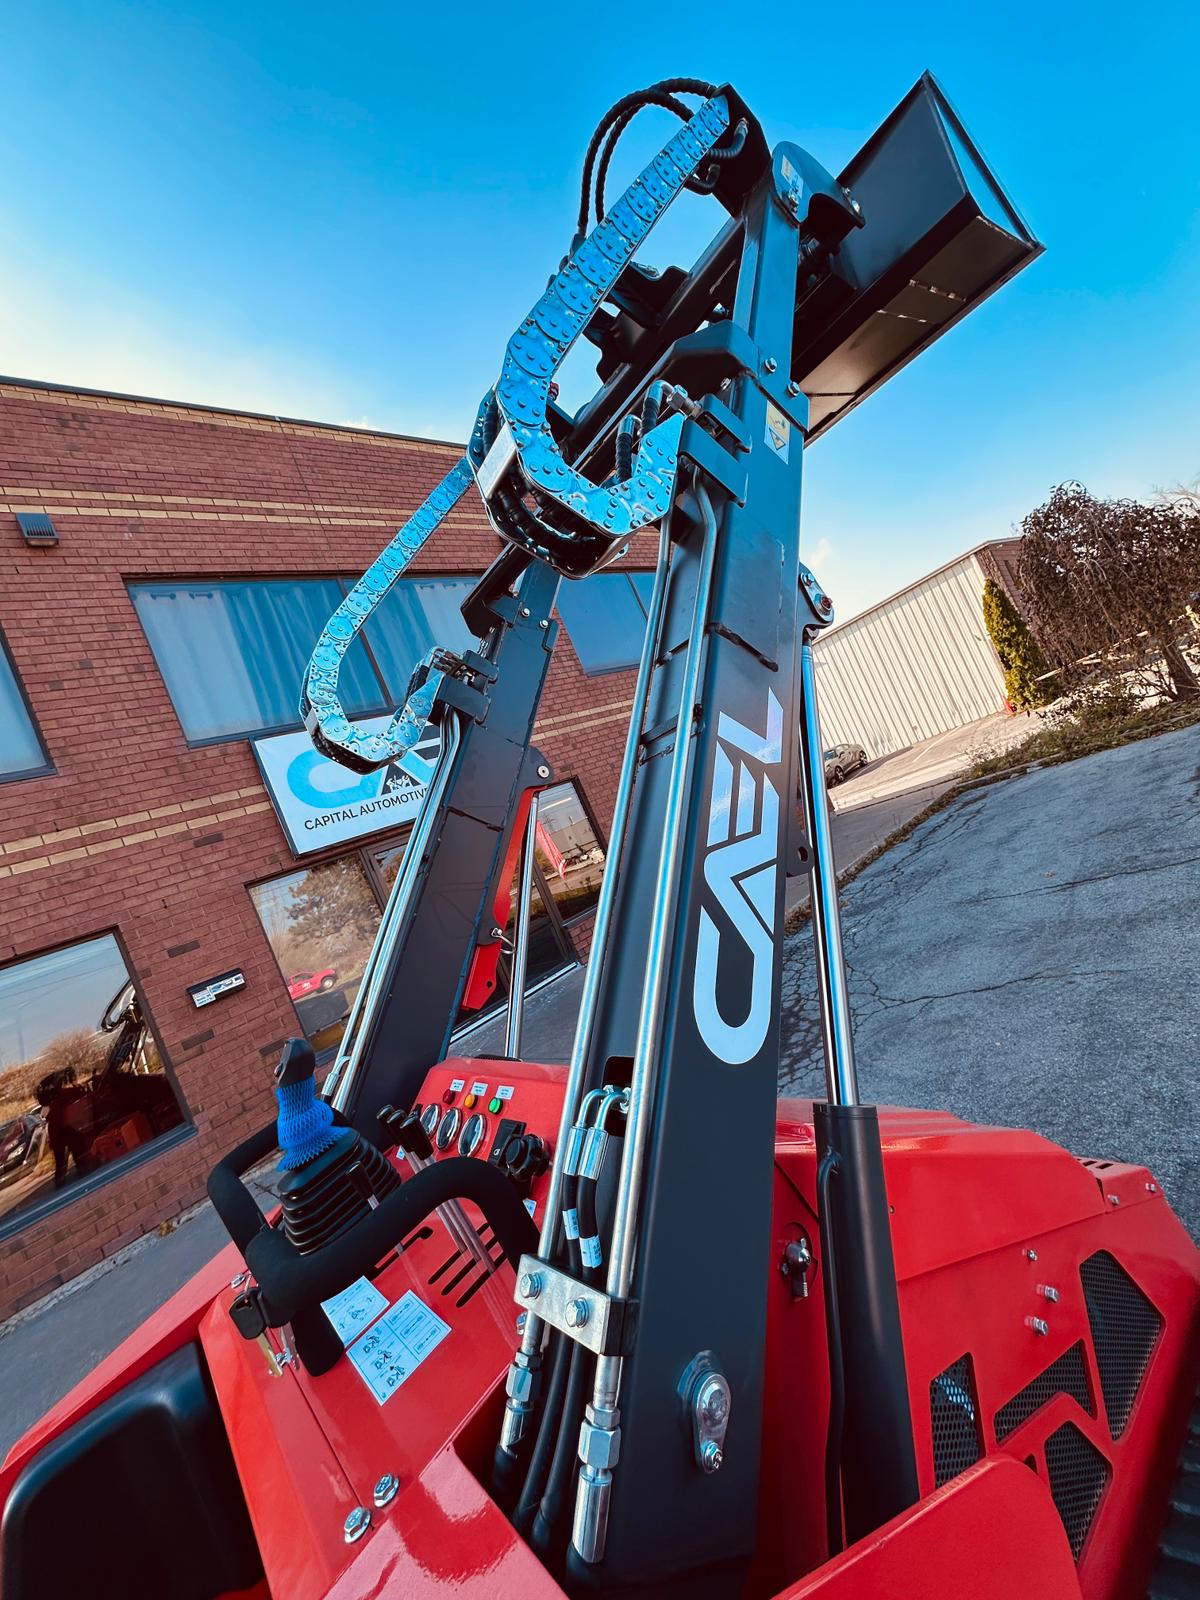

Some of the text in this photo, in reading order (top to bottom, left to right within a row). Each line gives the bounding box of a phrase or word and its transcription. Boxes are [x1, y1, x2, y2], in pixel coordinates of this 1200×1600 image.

[304, 787, 428, 831] CAPITAL AUTOMOTIV
[693, 686, 784, 1065] CAEL
